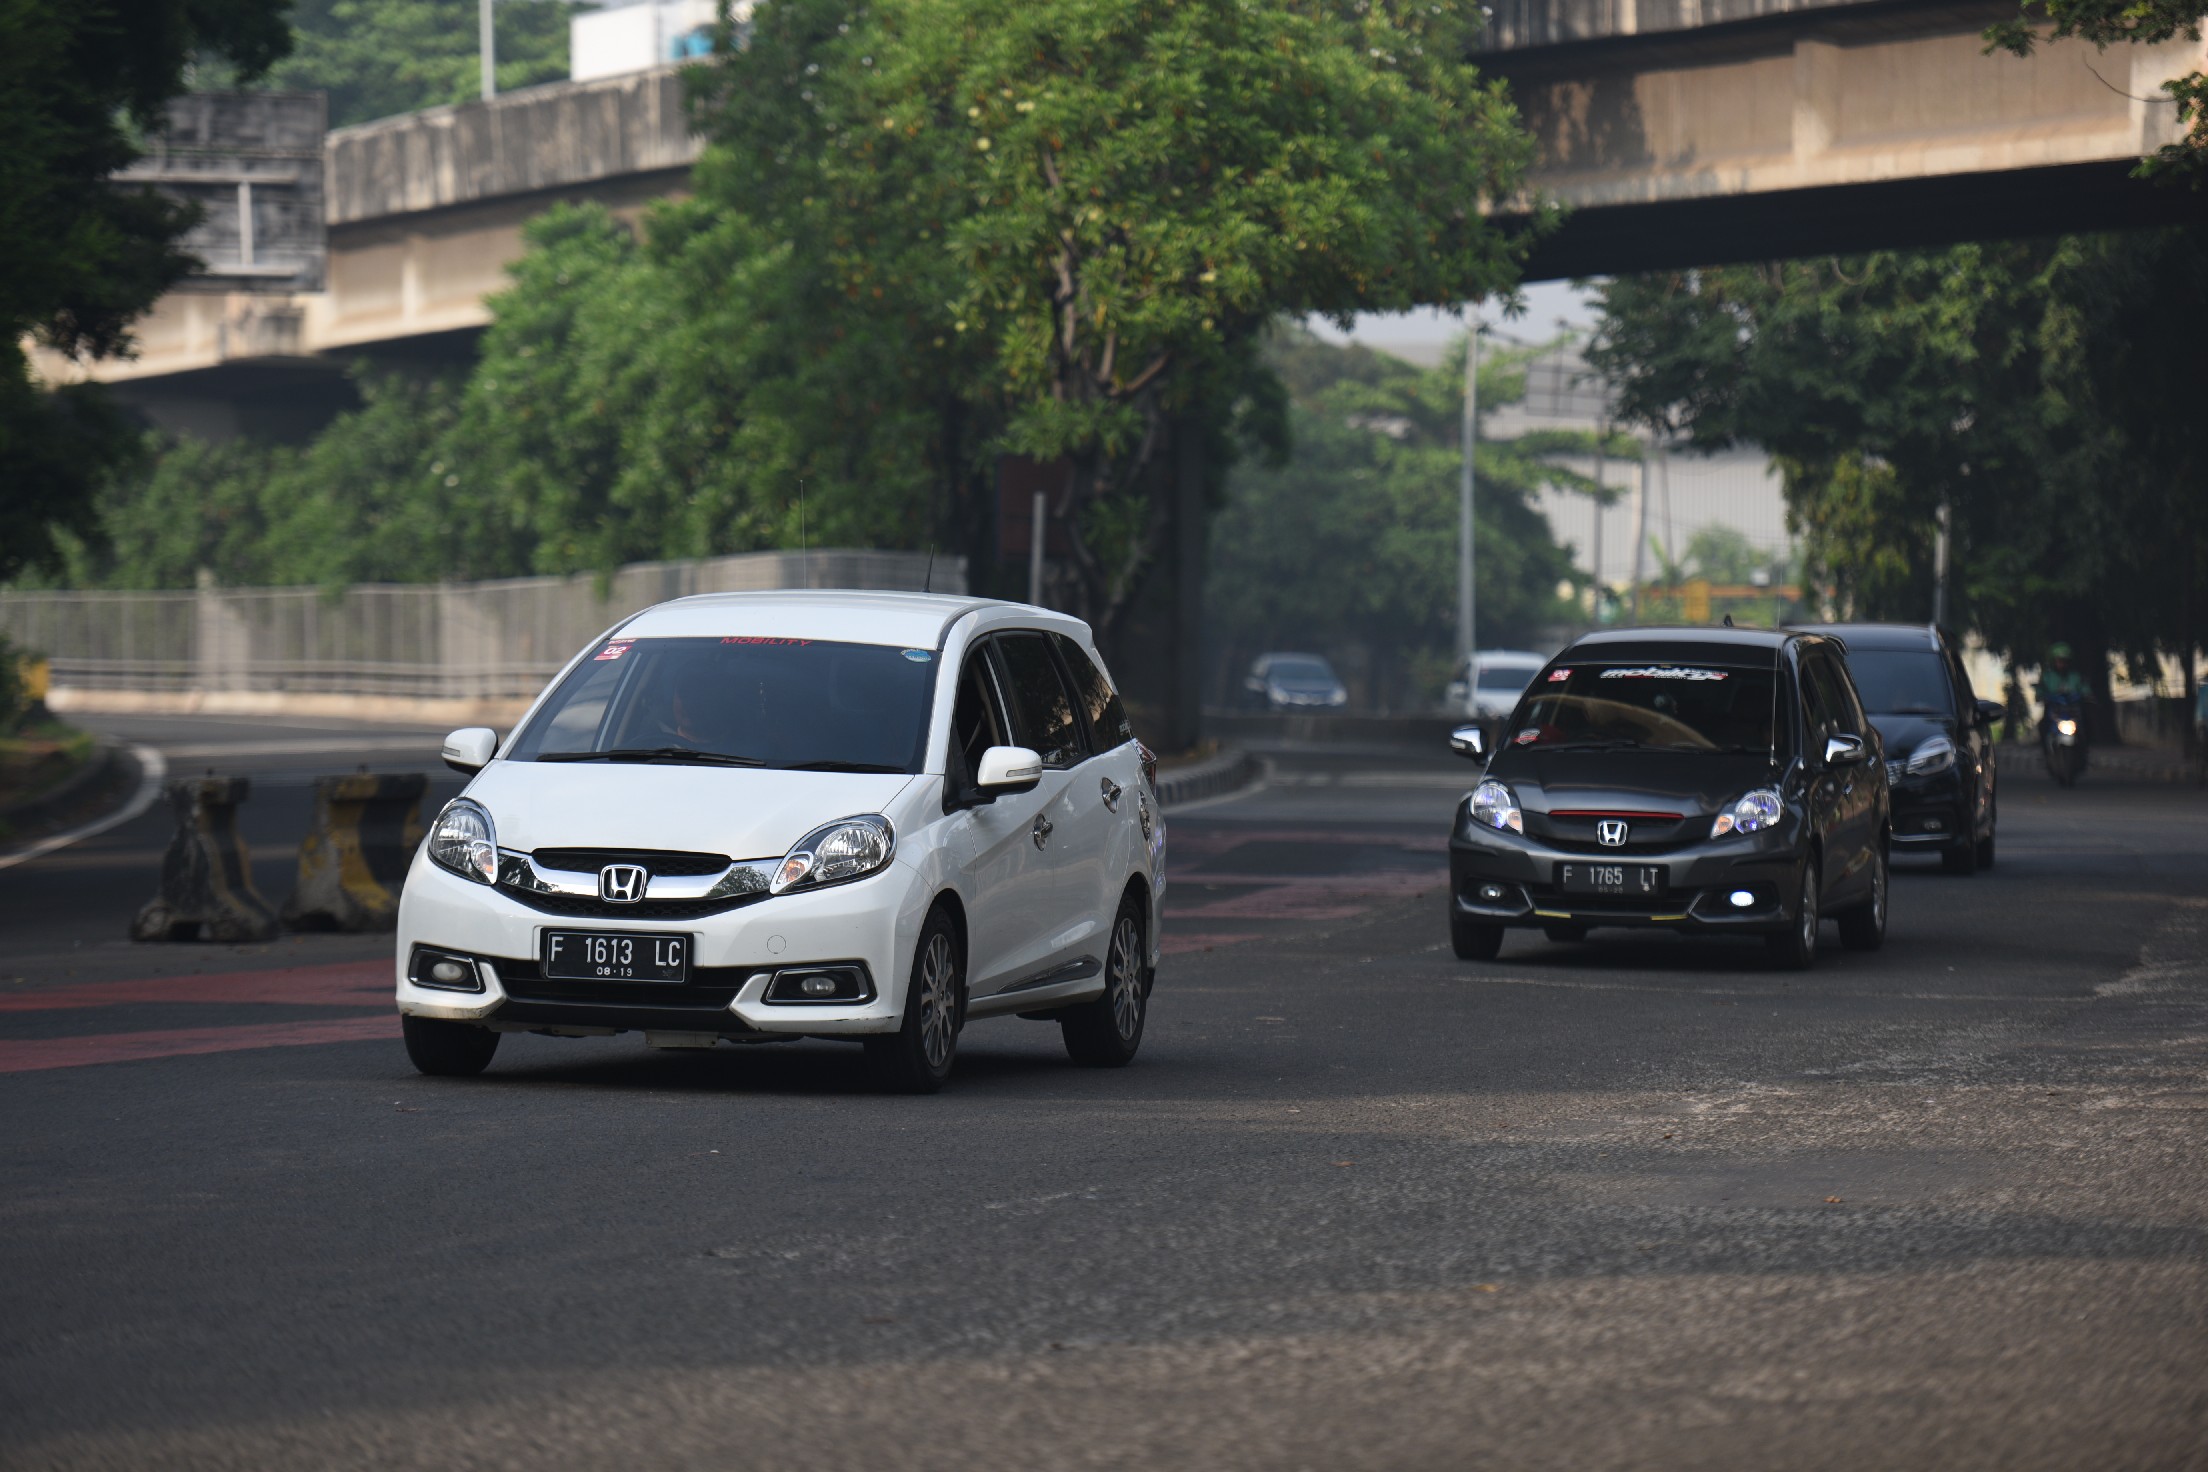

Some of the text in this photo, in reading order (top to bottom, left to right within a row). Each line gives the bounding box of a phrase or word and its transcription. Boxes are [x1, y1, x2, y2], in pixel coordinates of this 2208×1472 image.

[720, 637, 812, 646] MOBILITY
[1563, 865, 1659, 887] F 1765 LT
[551, 937, 681, 967] F 1613 LC
